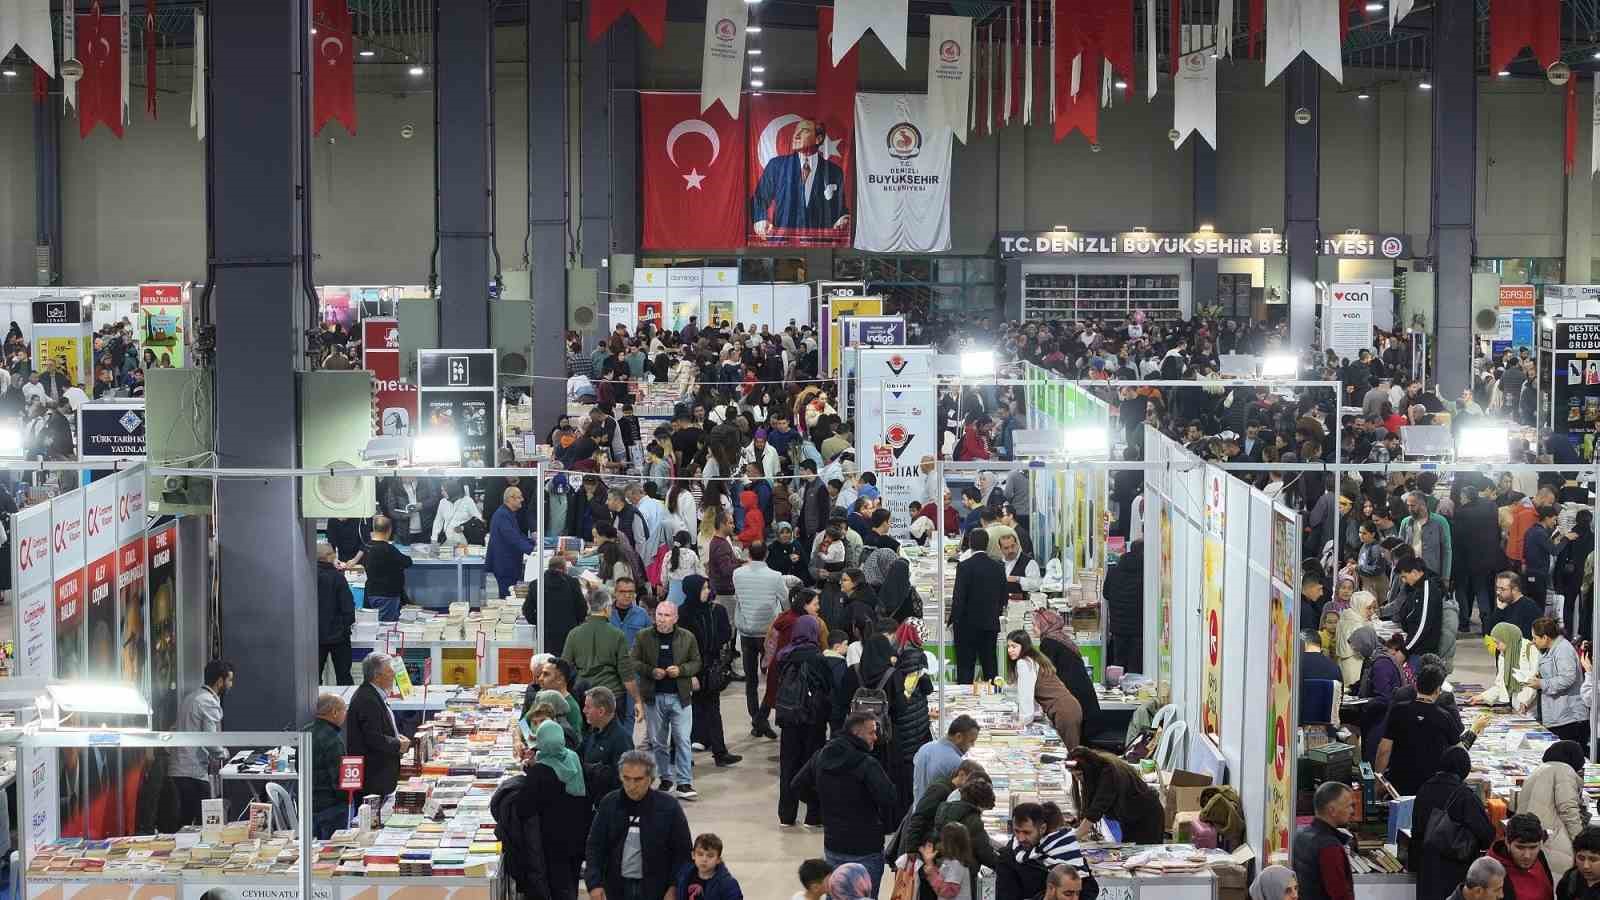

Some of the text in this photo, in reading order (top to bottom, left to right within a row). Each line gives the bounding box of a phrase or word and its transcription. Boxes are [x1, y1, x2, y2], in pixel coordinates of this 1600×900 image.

[1000, 237, 1033, 252] T.C.
[1036, 236, 1117, 252] DENİZLİ
[1123, 238, 1252, 254] BÜYÜKŞEHİR
[1345, 292, 1369, 301] can
[1569, 324, 1600, 332] DESTEK
[1569, 333, 1599, 341] MEDYA
[1568, 341, 1600, 349] GRUBU
[91, 434, 112, 443] TÜRK
[113, 434, 136, 443] TARİH
[344, 768, 360, 777] 30
